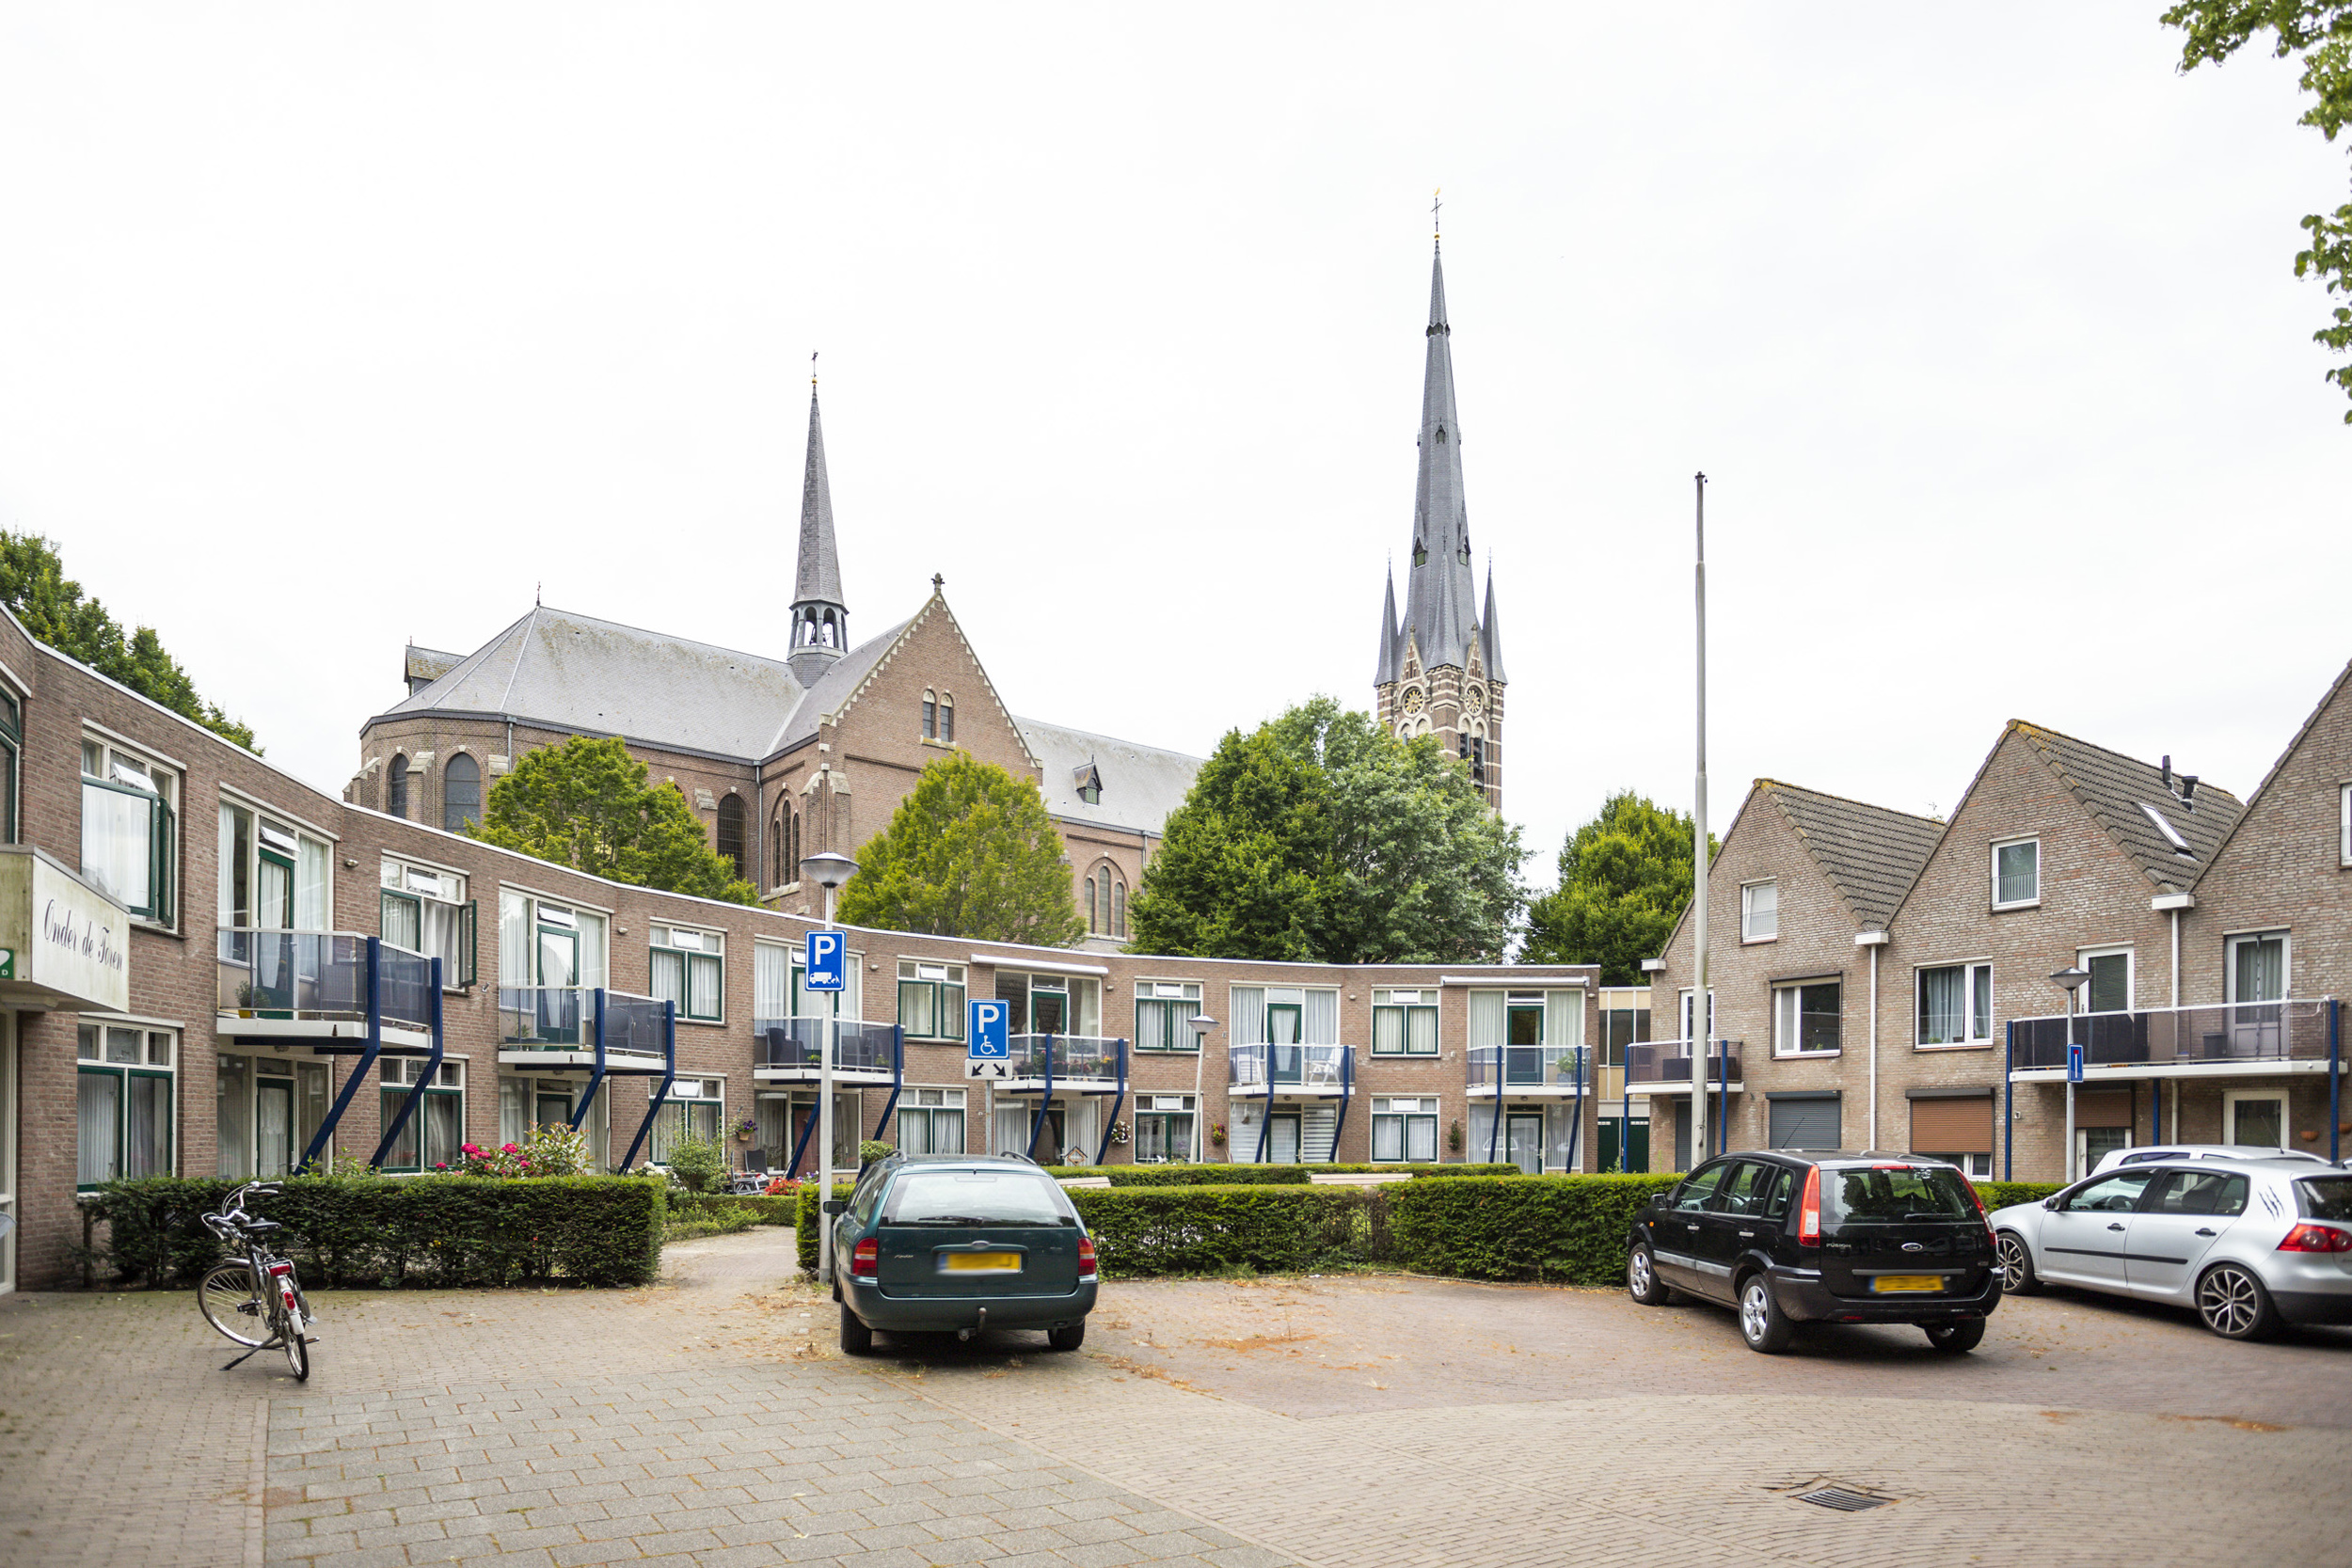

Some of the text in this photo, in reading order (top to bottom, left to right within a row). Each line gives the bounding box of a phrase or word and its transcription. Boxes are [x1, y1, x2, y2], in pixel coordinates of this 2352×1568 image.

[44, 898, 123, 972] Onder de Toren
[815, 935, 836, 965] P
[978, 1005, 1000, 1034] P
